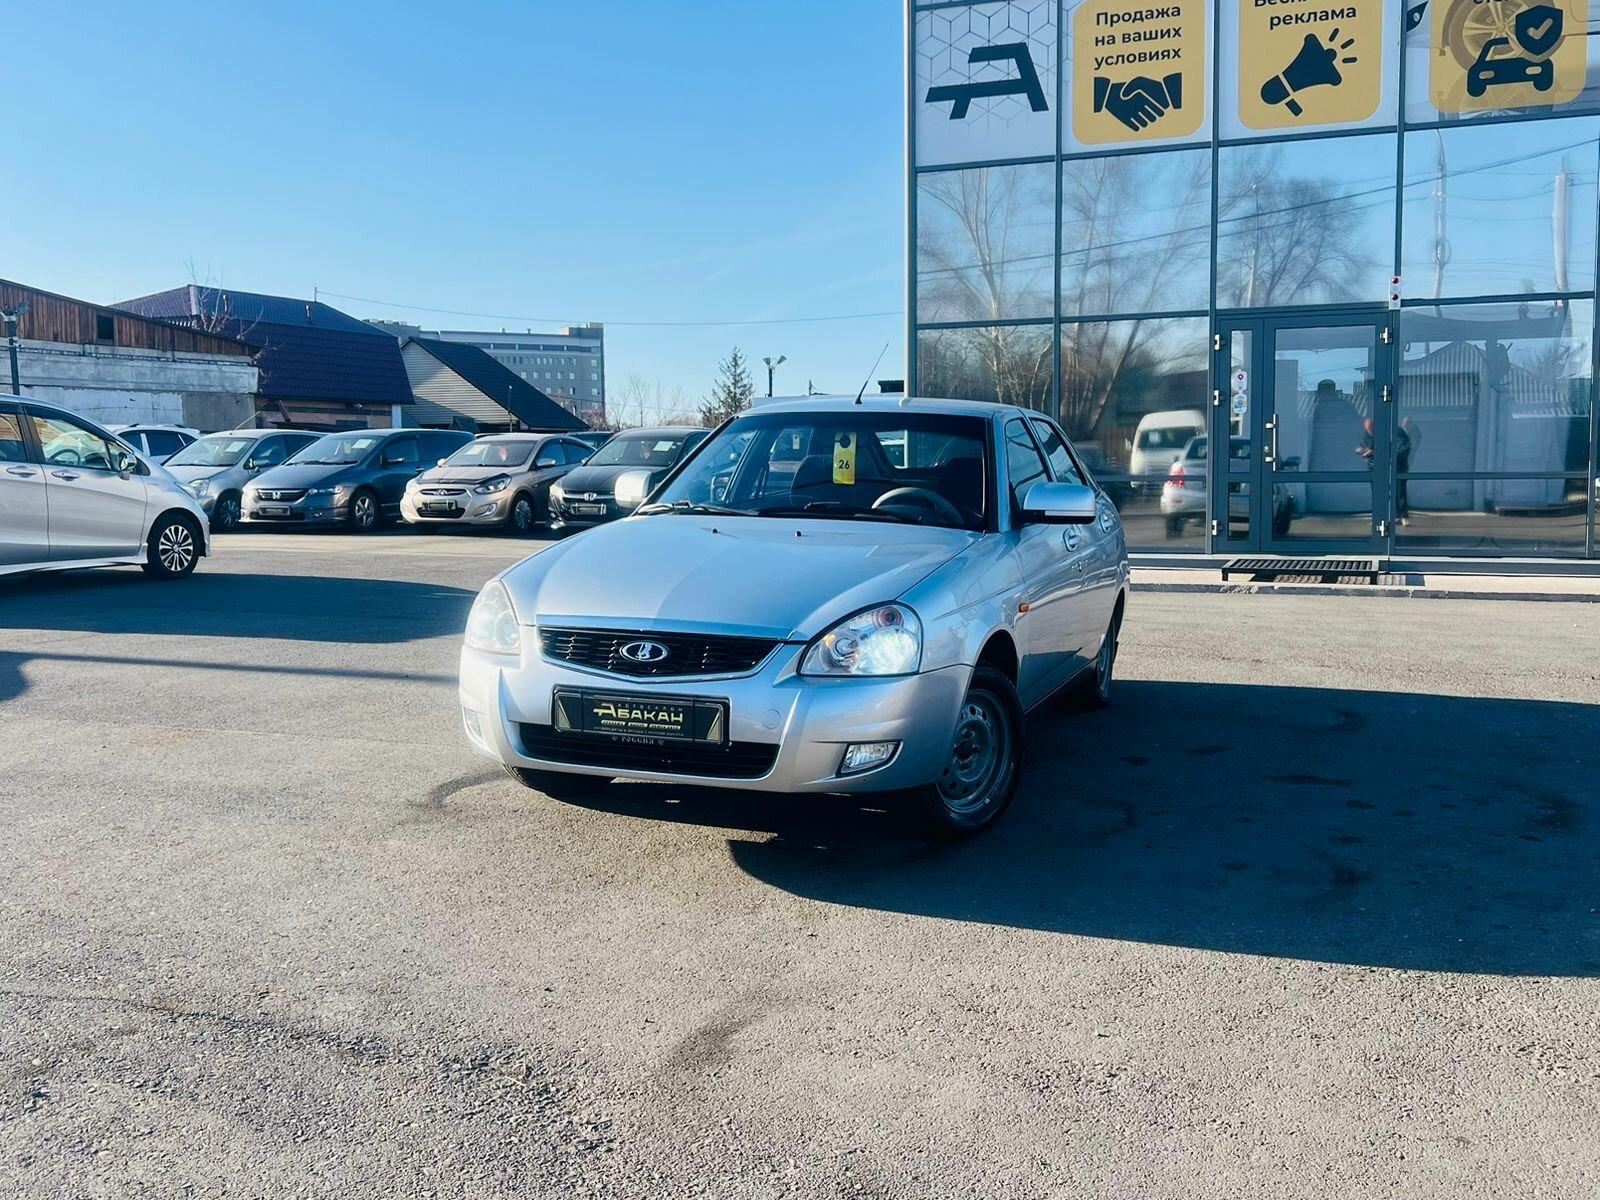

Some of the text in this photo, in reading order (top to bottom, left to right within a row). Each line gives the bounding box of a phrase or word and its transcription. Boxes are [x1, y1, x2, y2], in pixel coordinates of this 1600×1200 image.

[1096, 6, 1181, 27] Продажа
[1269, 6, 1357, 30] реклама
[1095, 26, 1182, 47] на ваших
[1093, 48, 1182, 71] условиях
[838, 459, 850, 470] 26
